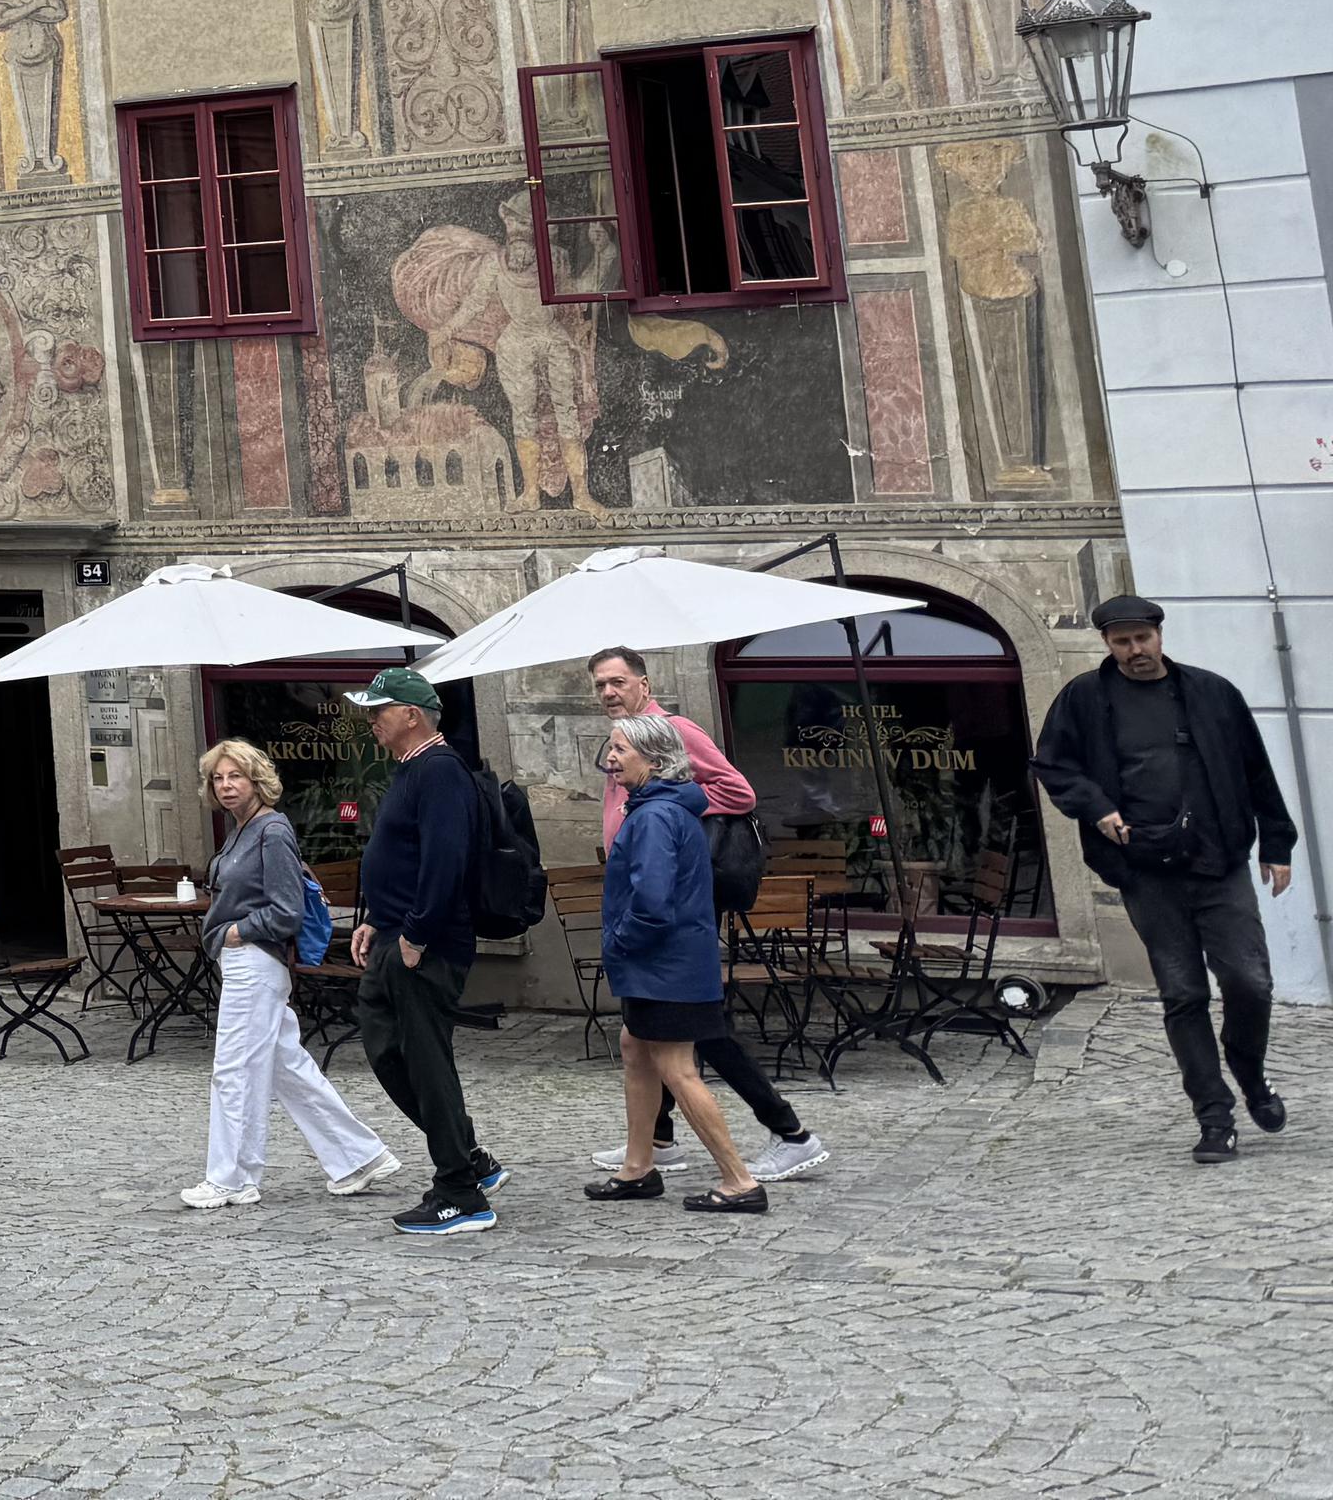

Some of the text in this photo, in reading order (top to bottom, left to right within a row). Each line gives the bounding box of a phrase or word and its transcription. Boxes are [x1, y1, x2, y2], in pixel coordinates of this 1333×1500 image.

[83, 564, 103, 577] 54
[910, 743, 978, 771] DŮM
[340, 804, 358, 820] illy
